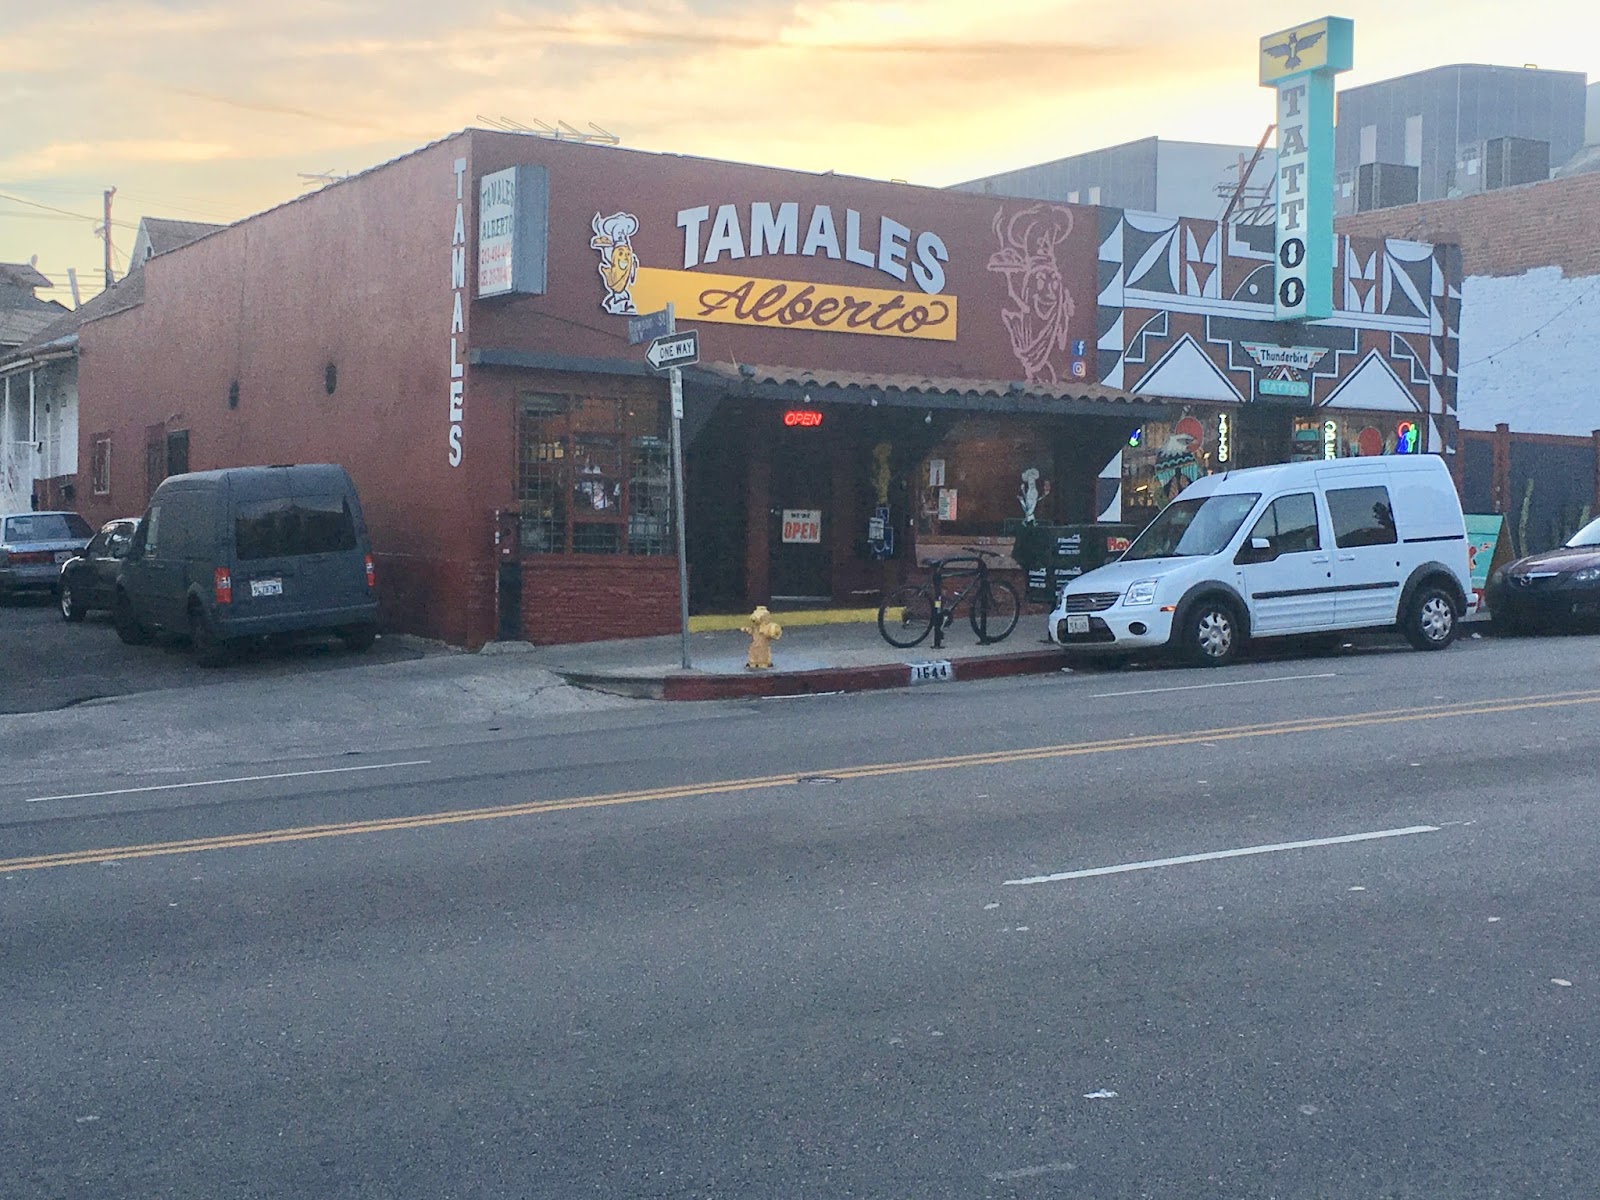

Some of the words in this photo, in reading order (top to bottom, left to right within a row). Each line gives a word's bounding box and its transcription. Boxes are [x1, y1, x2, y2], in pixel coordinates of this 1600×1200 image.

[1279, 84, 1308, 308] TATTOO
[481, 215, 514, 240] ALBERTO
[677, 202, 949, 295] TAMALES
[449, 157, 466, 467] TAMALES
[698, 281, 949, 333] Alberto
[660, 346, 674, 359] ONE
[676, 342, 693, 356] WAY
[1260, 349, 1308, 364] Thunderbird
[1263, 381, 1306, 394] TATTOO
[784, 411, 822, 426] OPEN
[1218, 413, 1229, 462] TATTOO
[784, 521, 818, 539] OPEN
[916, 664, 947, 679] 1644
